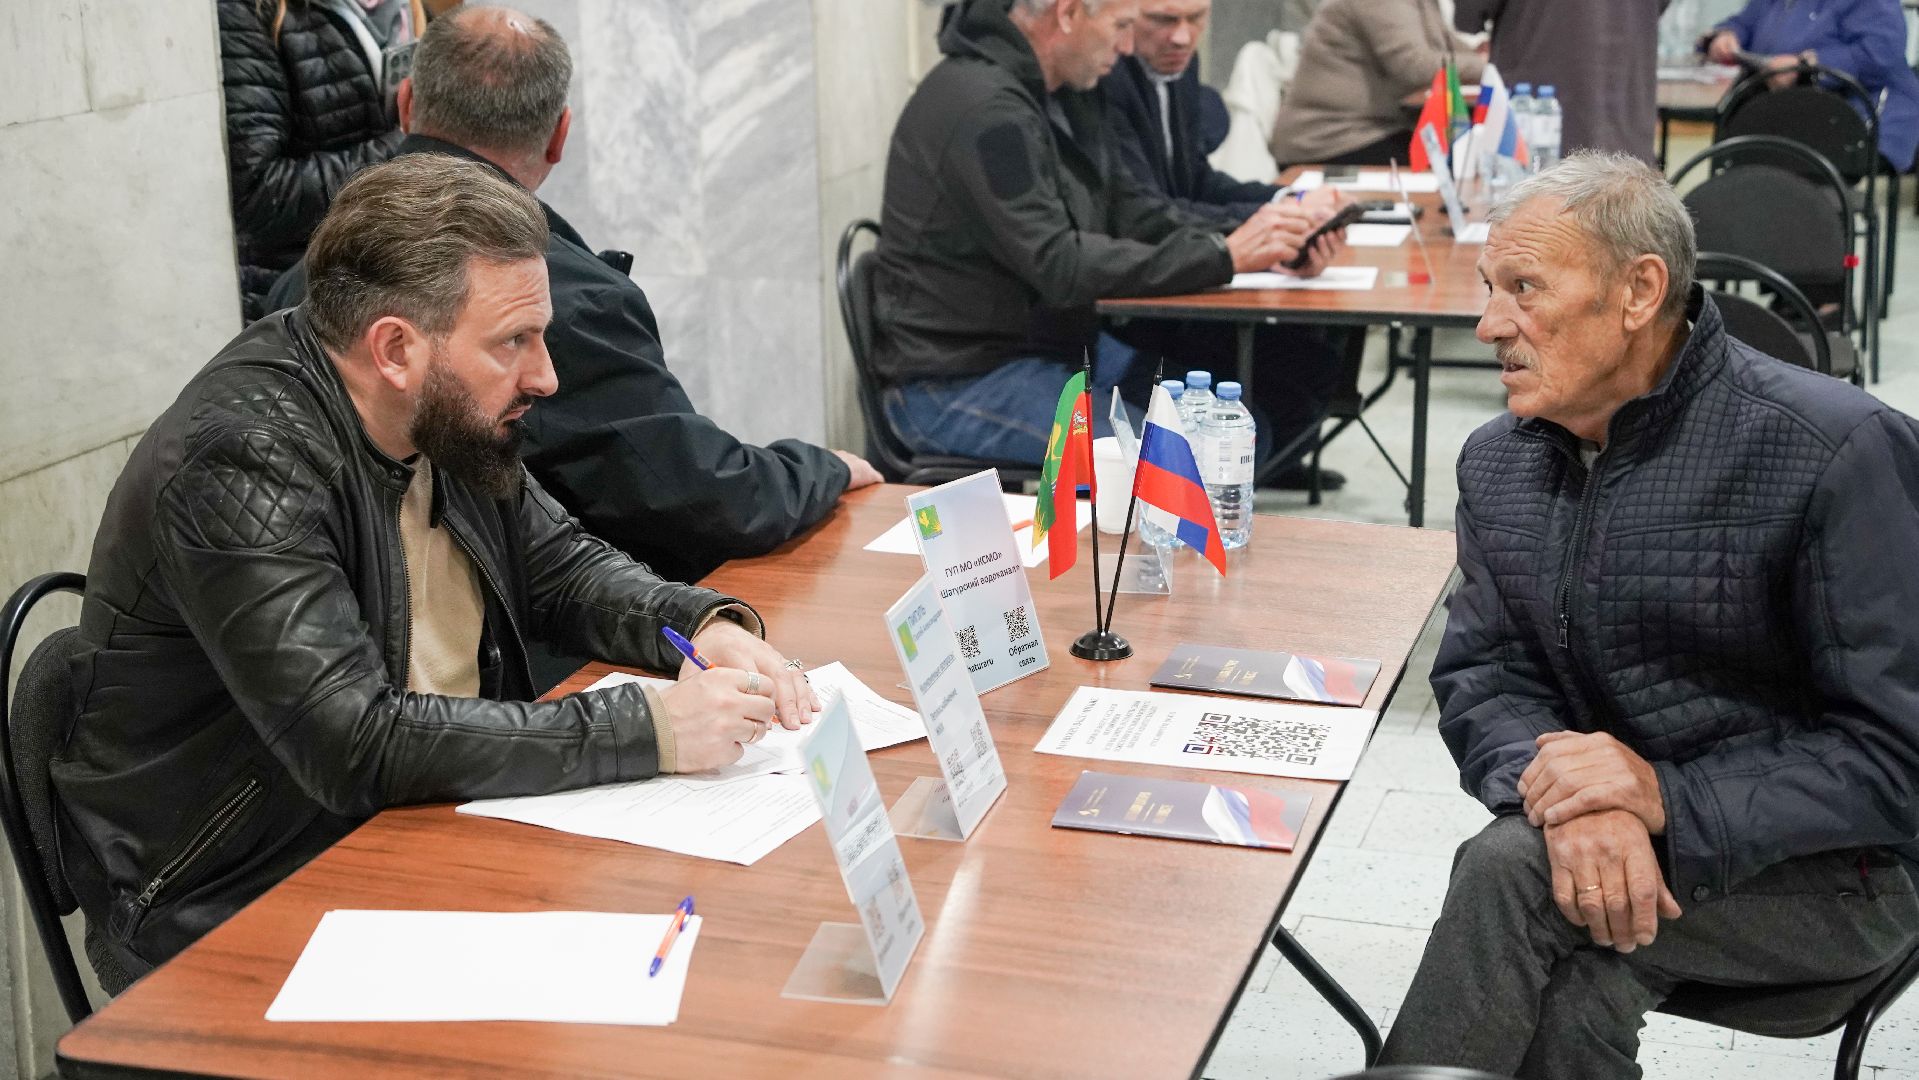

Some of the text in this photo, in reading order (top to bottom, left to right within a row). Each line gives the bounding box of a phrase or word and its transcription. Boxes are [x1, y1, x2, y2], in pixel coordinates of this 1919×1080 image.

[945, 551, 1002, 578] ГУП МО «КСМО»
[940, 564, 1020, 599] Шатурский водоканал»
[1008, 639, 1039, 657] Обратная
[1018, 656, 1036, 667] связь
